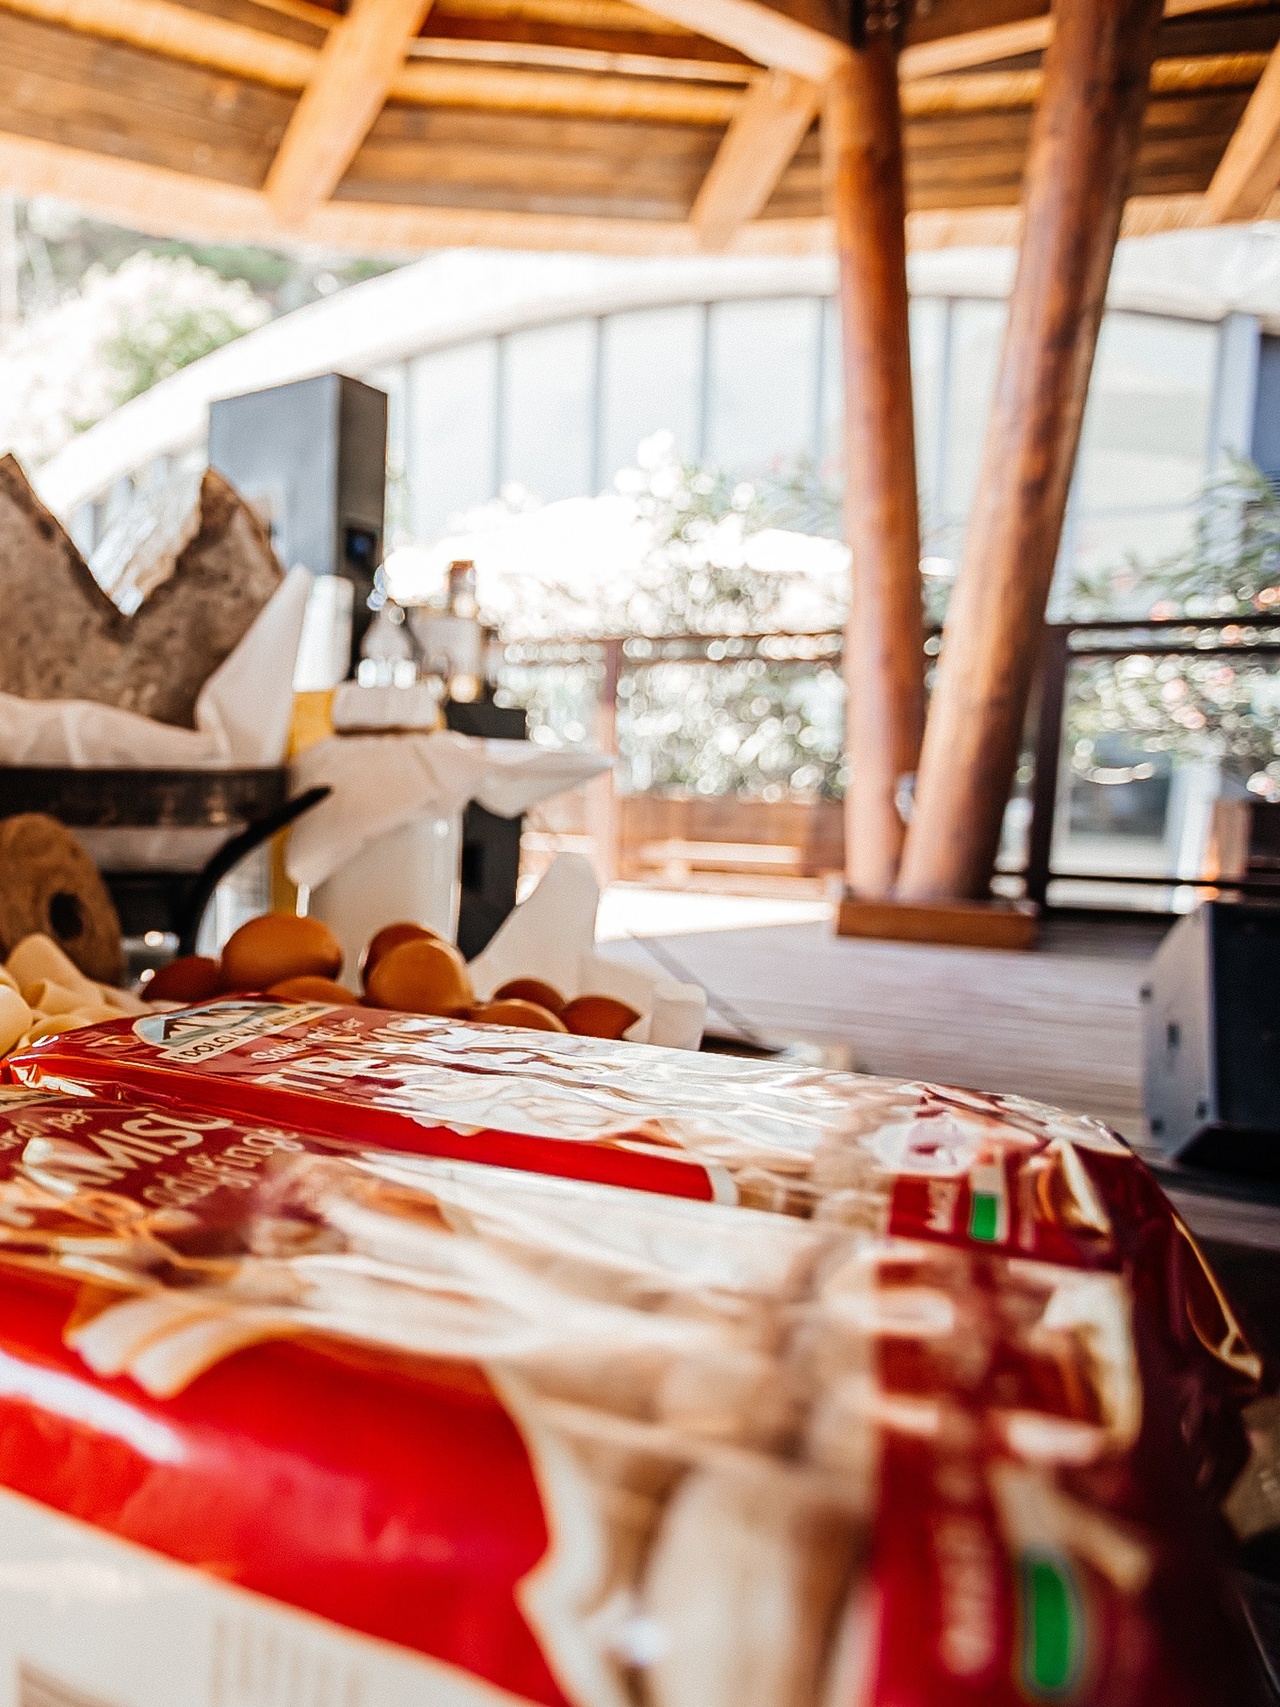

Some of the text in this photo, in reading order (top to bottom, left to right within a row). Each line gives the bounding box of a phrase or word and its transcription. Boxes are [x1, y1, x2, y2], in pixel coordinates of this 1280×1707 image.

[185, 1032, 237, 1058] DOLCI
[45, 1108, 94, 1134] per
[56, 1112, 234, 1186] MISU
[142, 1127, 306, 1206] adyfinge
